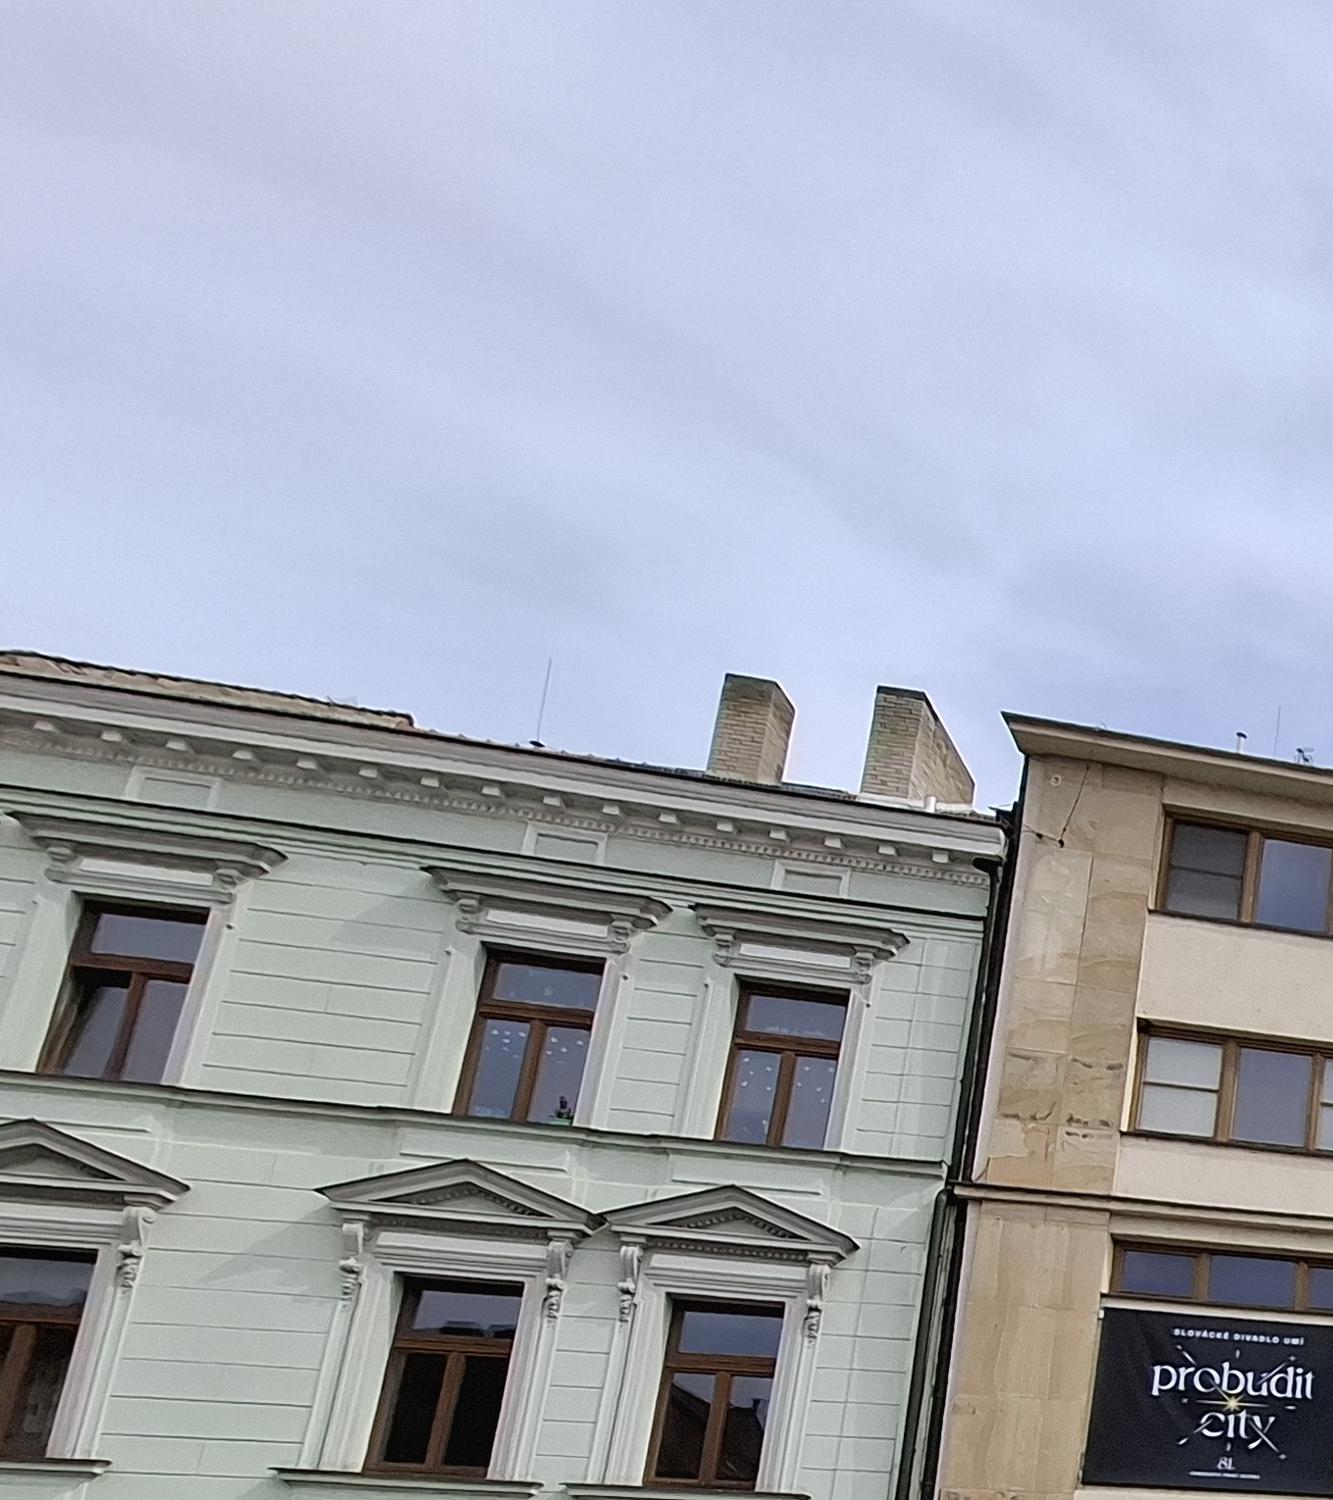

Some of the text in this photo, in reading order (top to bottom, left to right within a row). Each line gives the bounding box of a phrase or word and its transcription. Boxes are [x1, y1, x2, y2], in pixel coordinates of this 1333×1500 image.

[1233, 1332, 1280, 1344] DIVADLO
[1151, 1361, 1315, 1399] probudit
[1200, 1409, 1276, 1450] city
